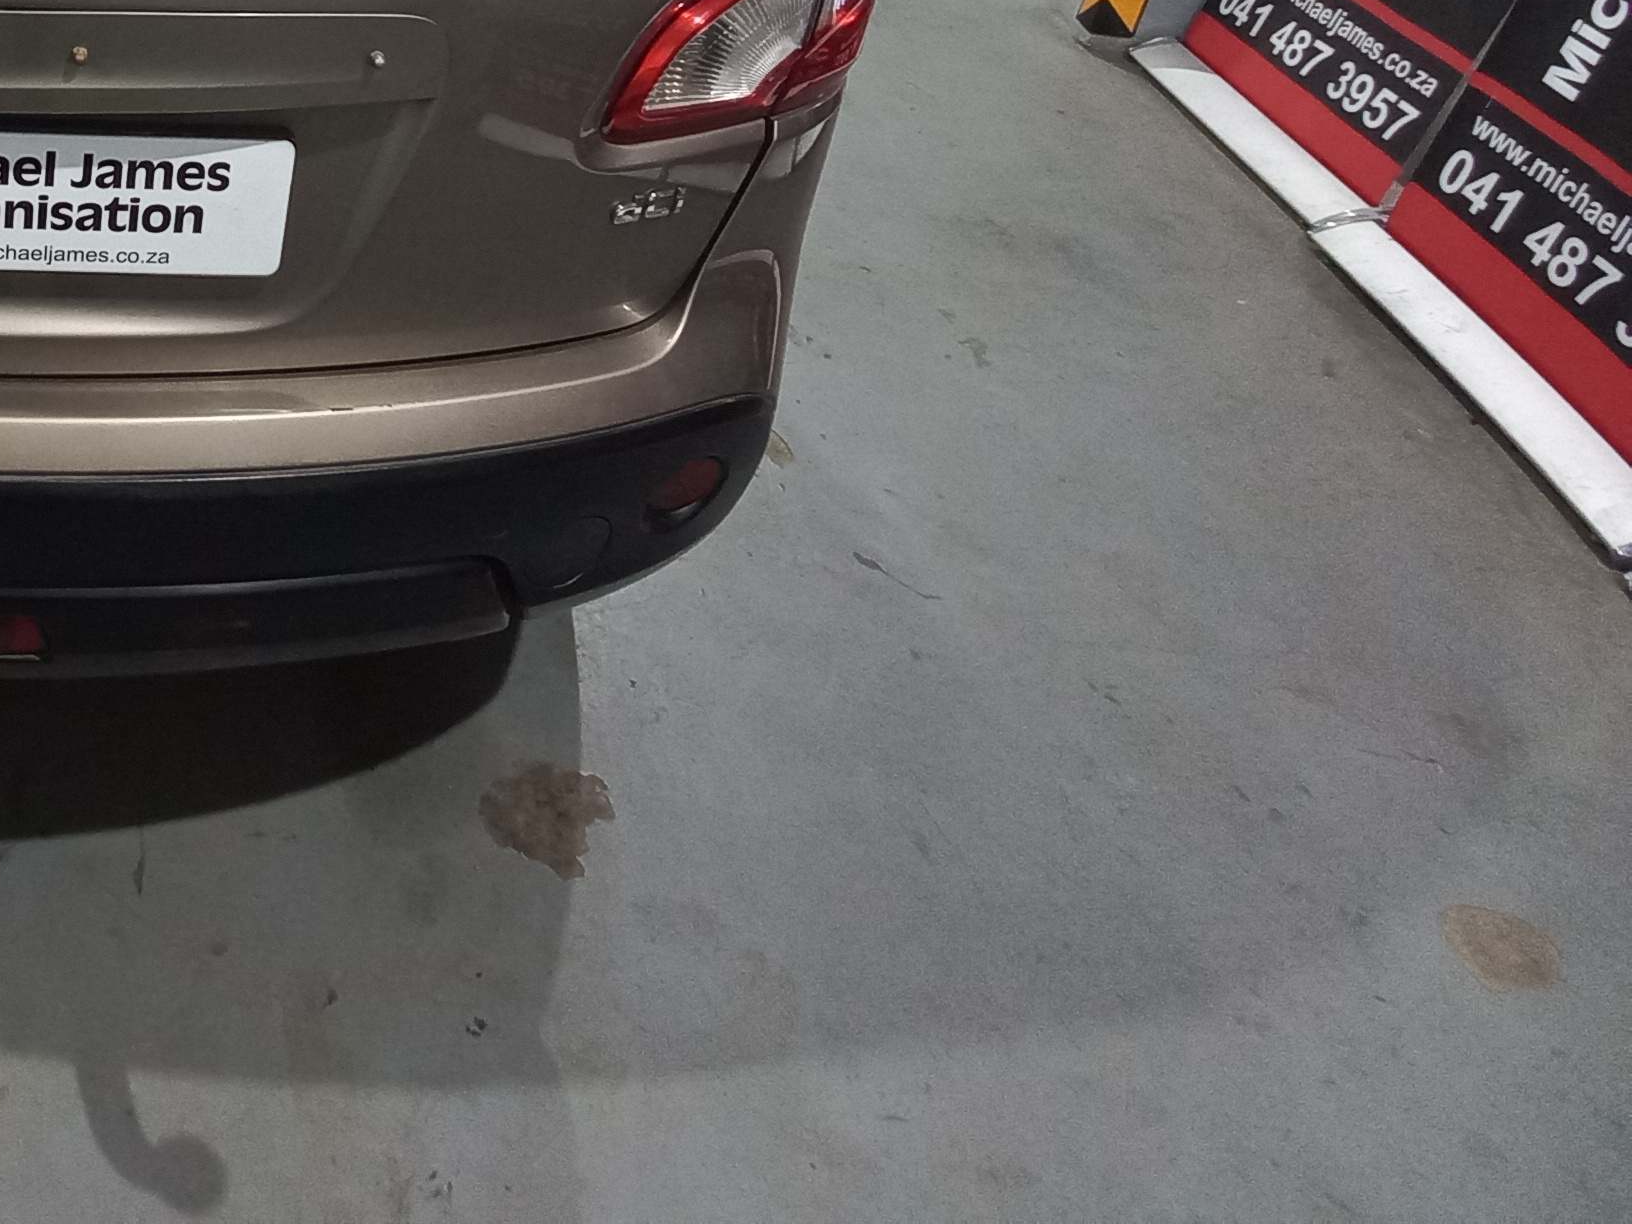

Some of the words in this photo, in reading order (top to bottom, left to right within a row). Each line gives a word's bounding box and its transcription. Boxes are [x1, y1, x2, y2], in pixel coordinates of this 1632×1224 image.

[1269, 21, 1335, 76] 487
[1326, 61, 1422, 140] 3957
[70, 153, 231, 192] James
[1439, 150, 1525, 233] 041
[1523, 221, 1625, 305] 487
[1471, 115, 1632, 255] www.michaelj
